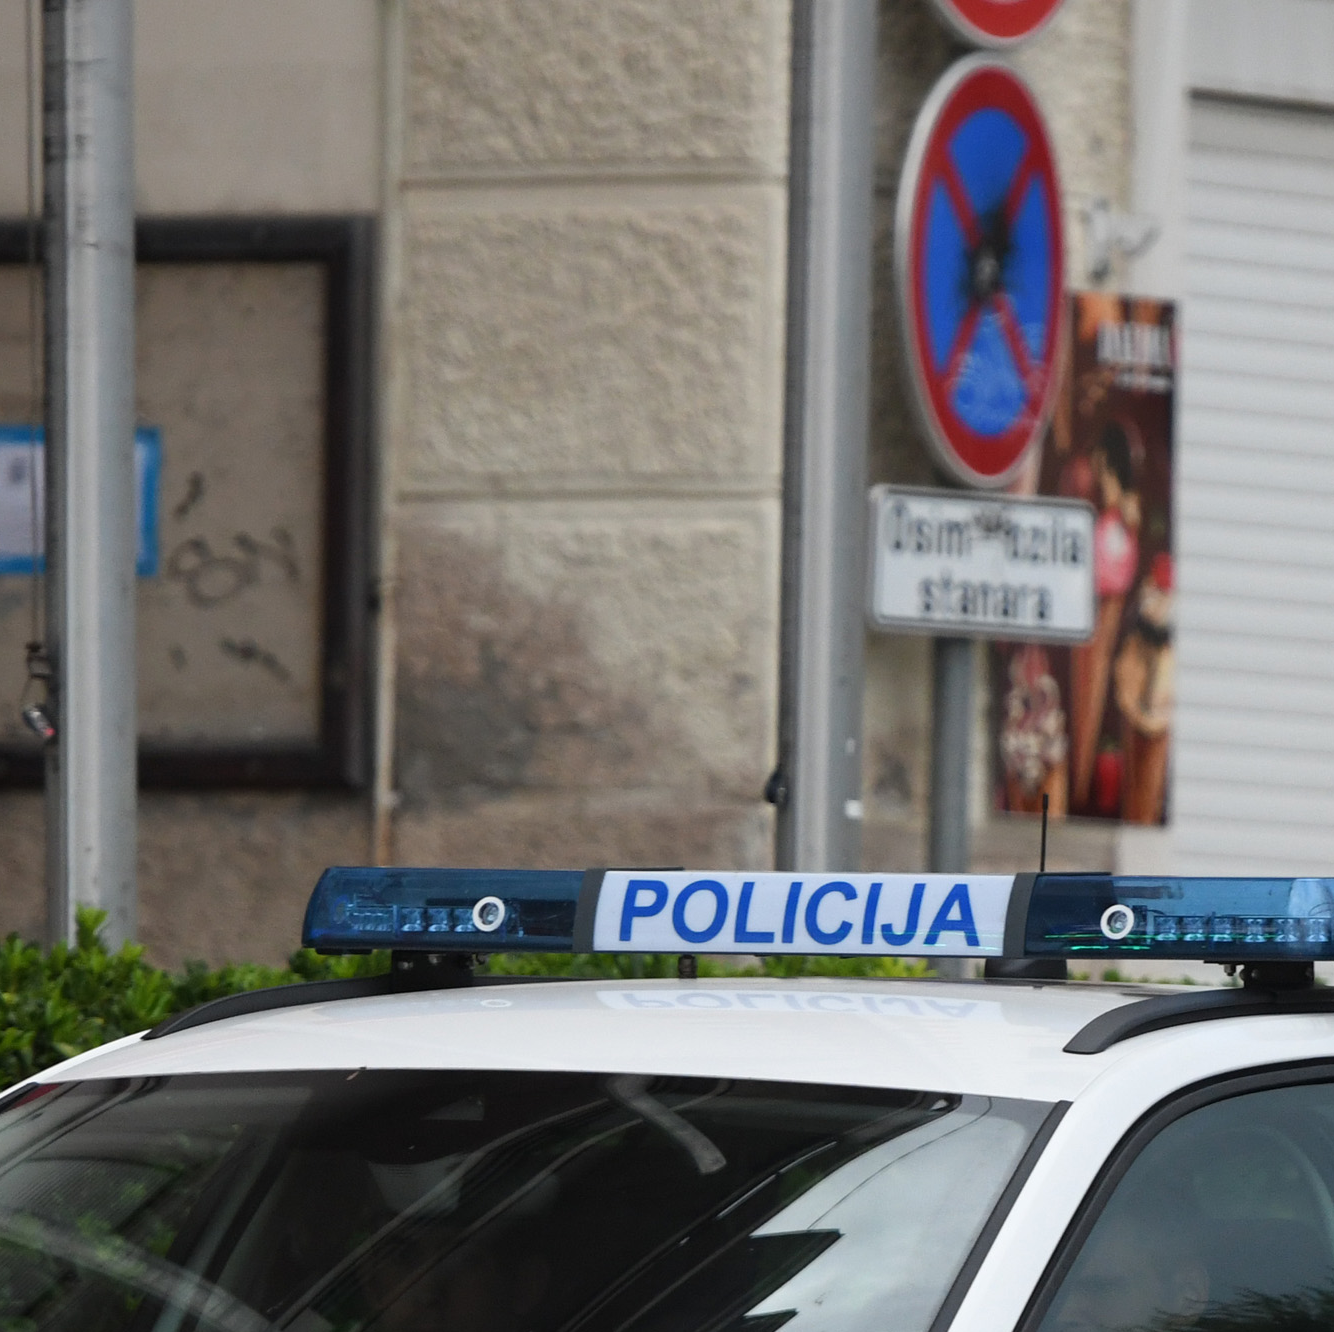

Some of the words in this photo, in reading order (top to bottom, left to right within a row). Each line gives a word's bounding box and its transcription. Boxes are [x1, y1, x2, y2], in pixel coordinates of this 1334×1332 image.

[887, 499, 970, 557] Osim
[919, 569, 1052, 621] stanara
[618, 879, 980, 947] POLICIJA
